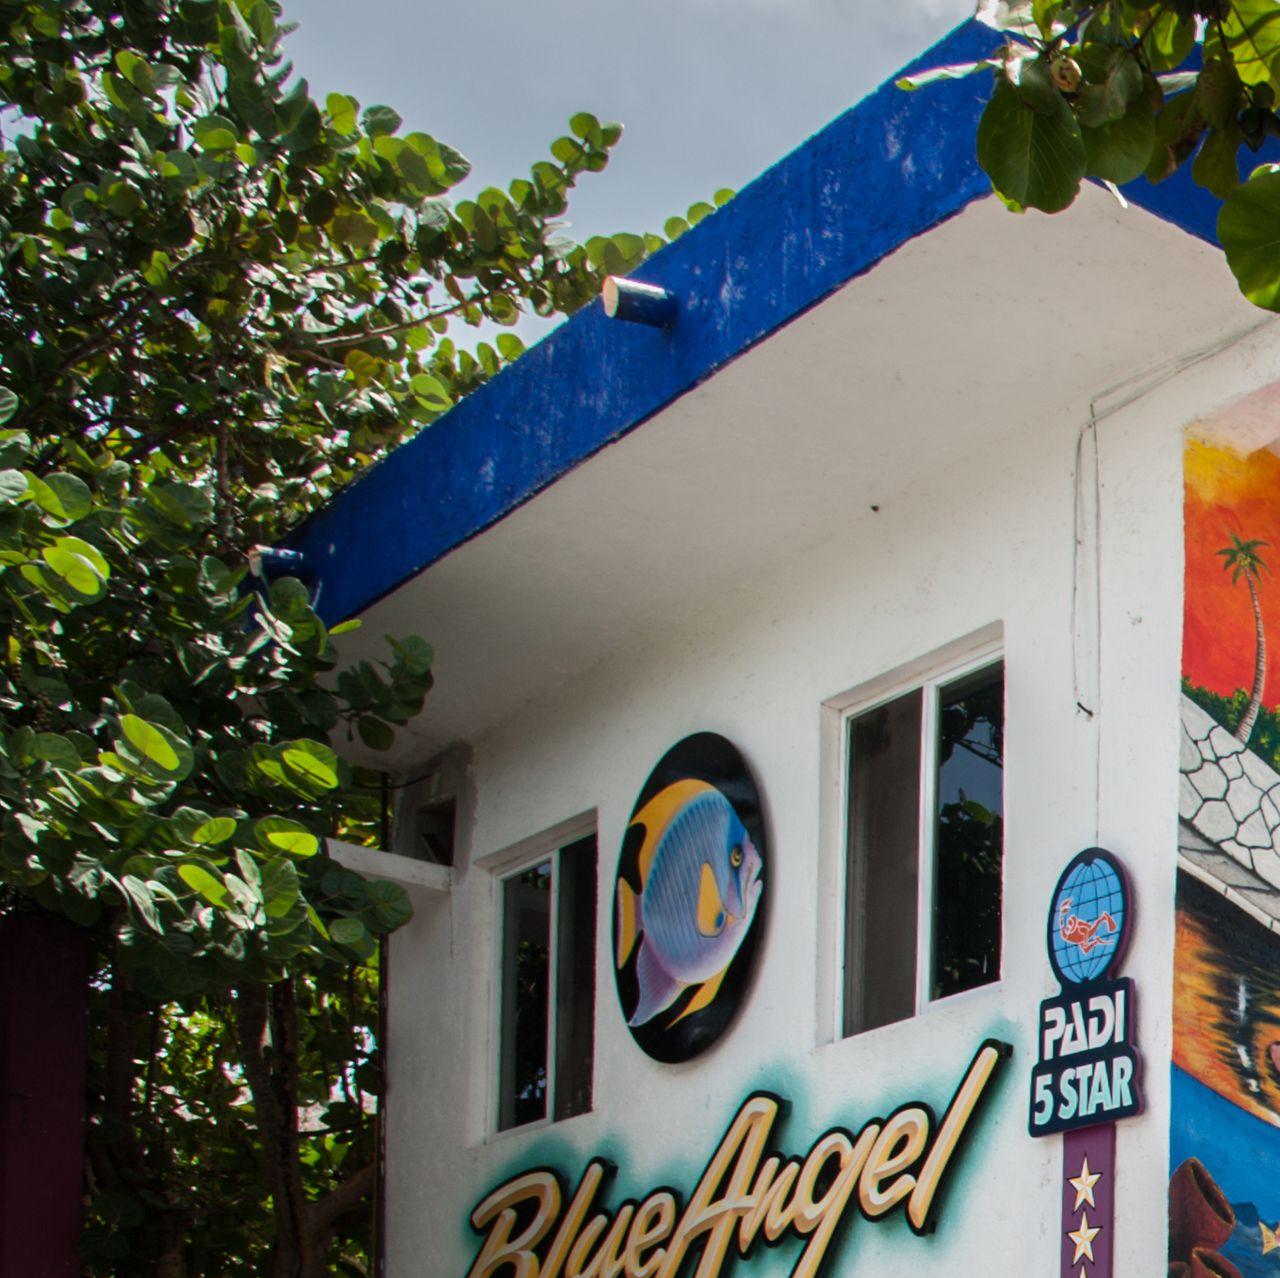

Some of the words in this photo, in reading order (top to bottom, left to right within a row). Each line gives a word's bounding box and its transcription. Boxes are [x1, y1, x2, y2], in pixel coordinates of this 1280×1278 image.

[1043, 990, 1125, 1061] PADI
[1034, 1073, 1053, 1126] 5
[1058, 1055, 1133, 1120] STAR
